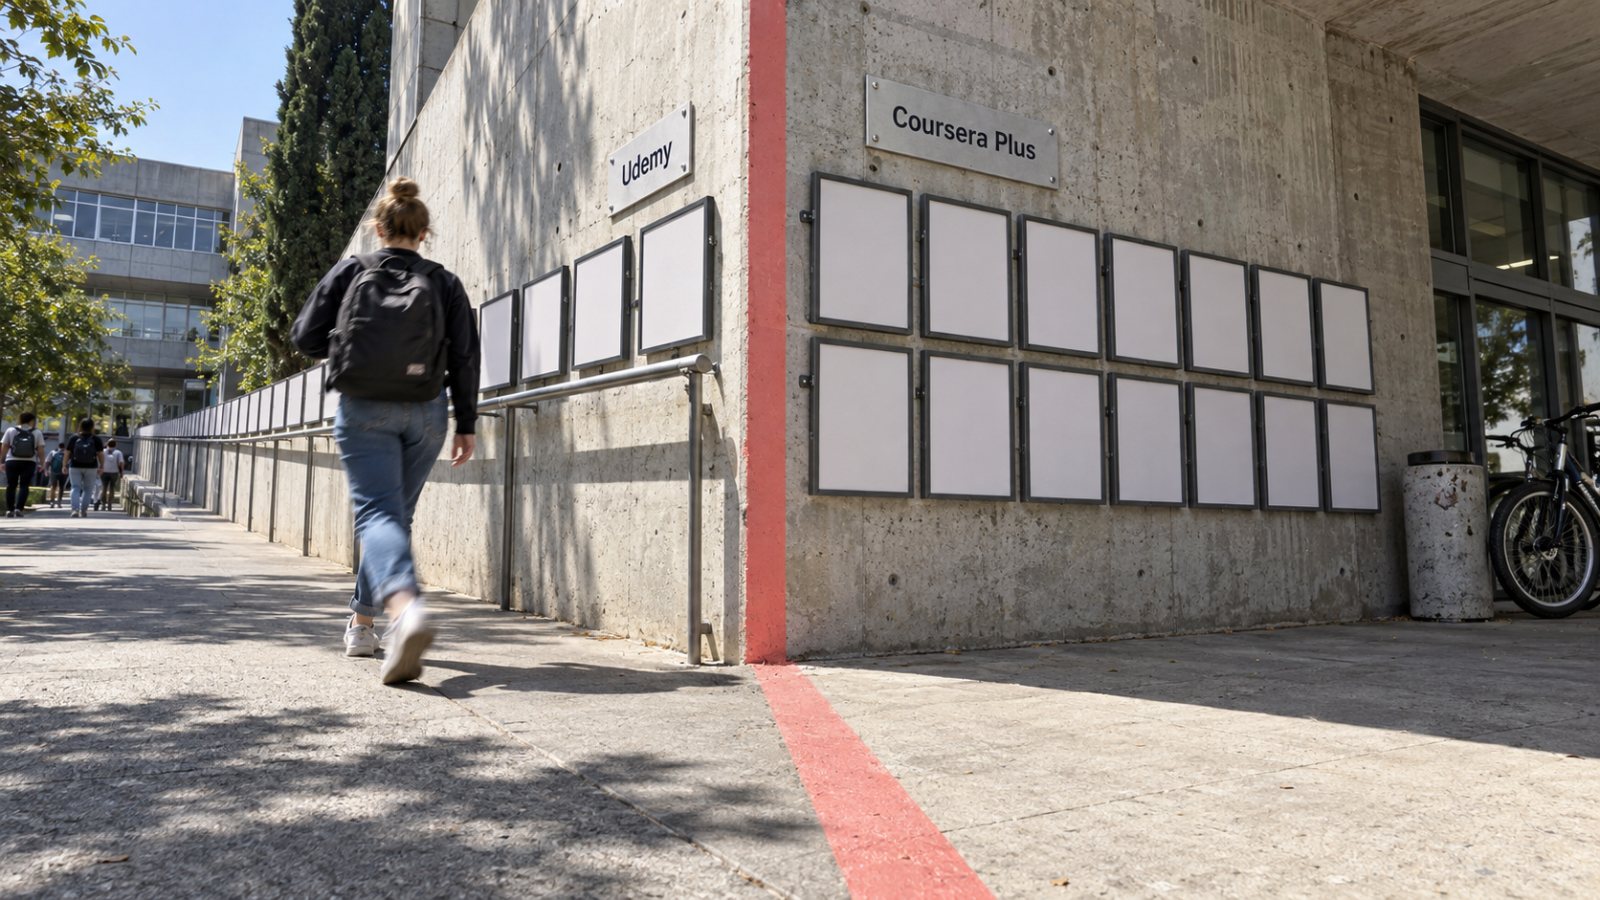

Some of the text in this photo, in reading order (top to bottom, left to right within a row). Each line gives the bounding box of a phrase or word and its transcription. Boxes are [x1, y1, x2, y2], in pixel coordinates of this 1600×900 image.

[893, 106, 1036, 160] Coursera Plus
[622, 140, 672, 186] Udemy
